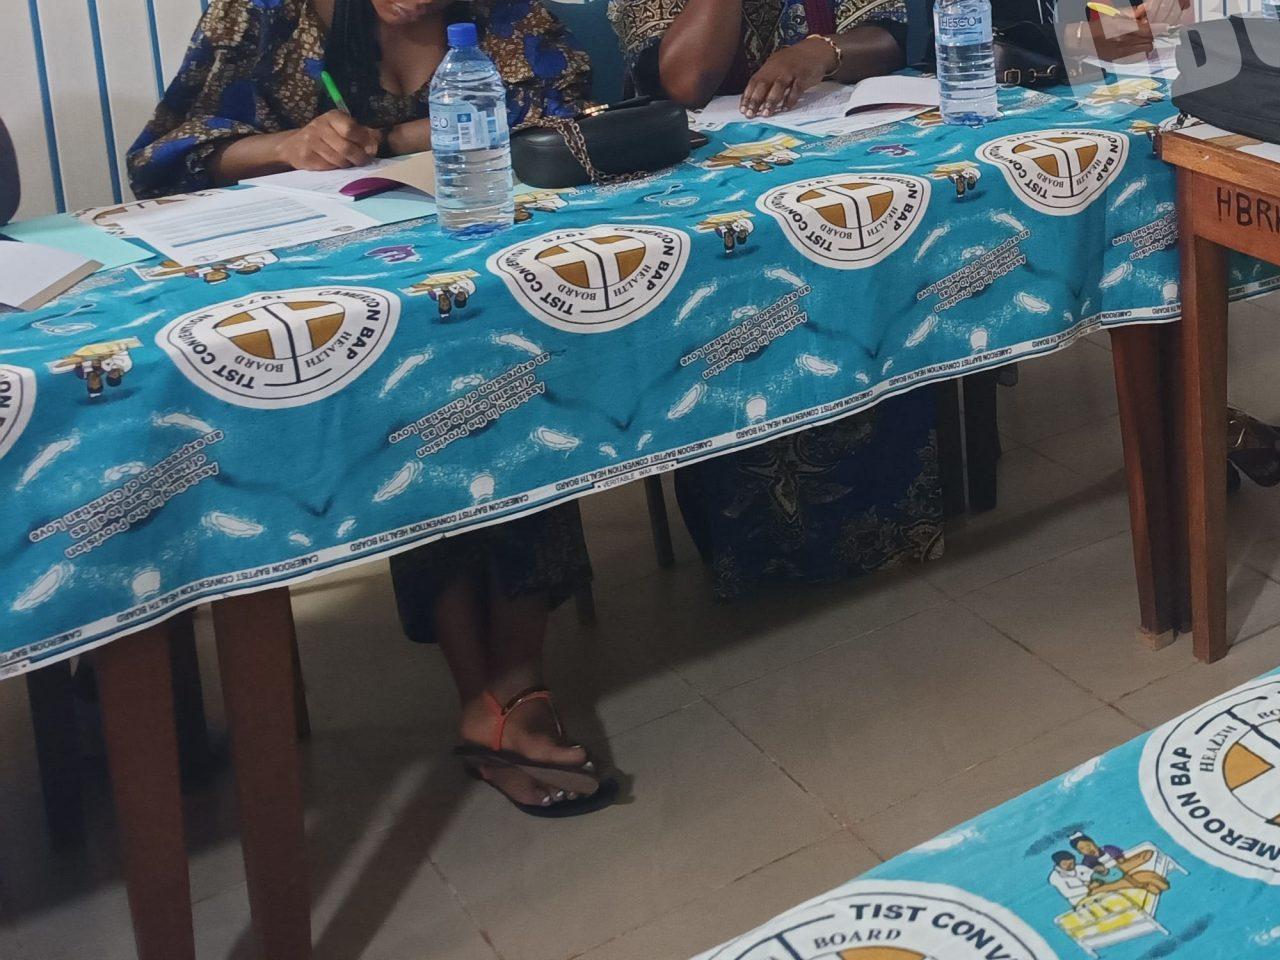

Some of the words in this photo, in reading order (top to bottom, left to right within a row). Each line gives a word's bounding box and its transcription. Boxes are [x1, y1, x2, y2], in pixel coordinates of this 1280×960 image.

[941, 16, 976, 28] HESCO
[305, 331, 352, 368] HEALTH
[347, 327, 374, 360] BAP
[236, 355, 284, 372] BOARD
[213, 365, 254, 389] TIST
[650, 450, 677, 463] BAPTIST
[677, 440, 713, 456] CAMEROON
[608, 458, 648, 476] CONVENTION
[1199, 725, 1239, 773] HEALTH
[1170, 746, 1192, 788] BAP
[849, 903, 931, 922] TIST
[814, 928, 901, 950] BOARD
